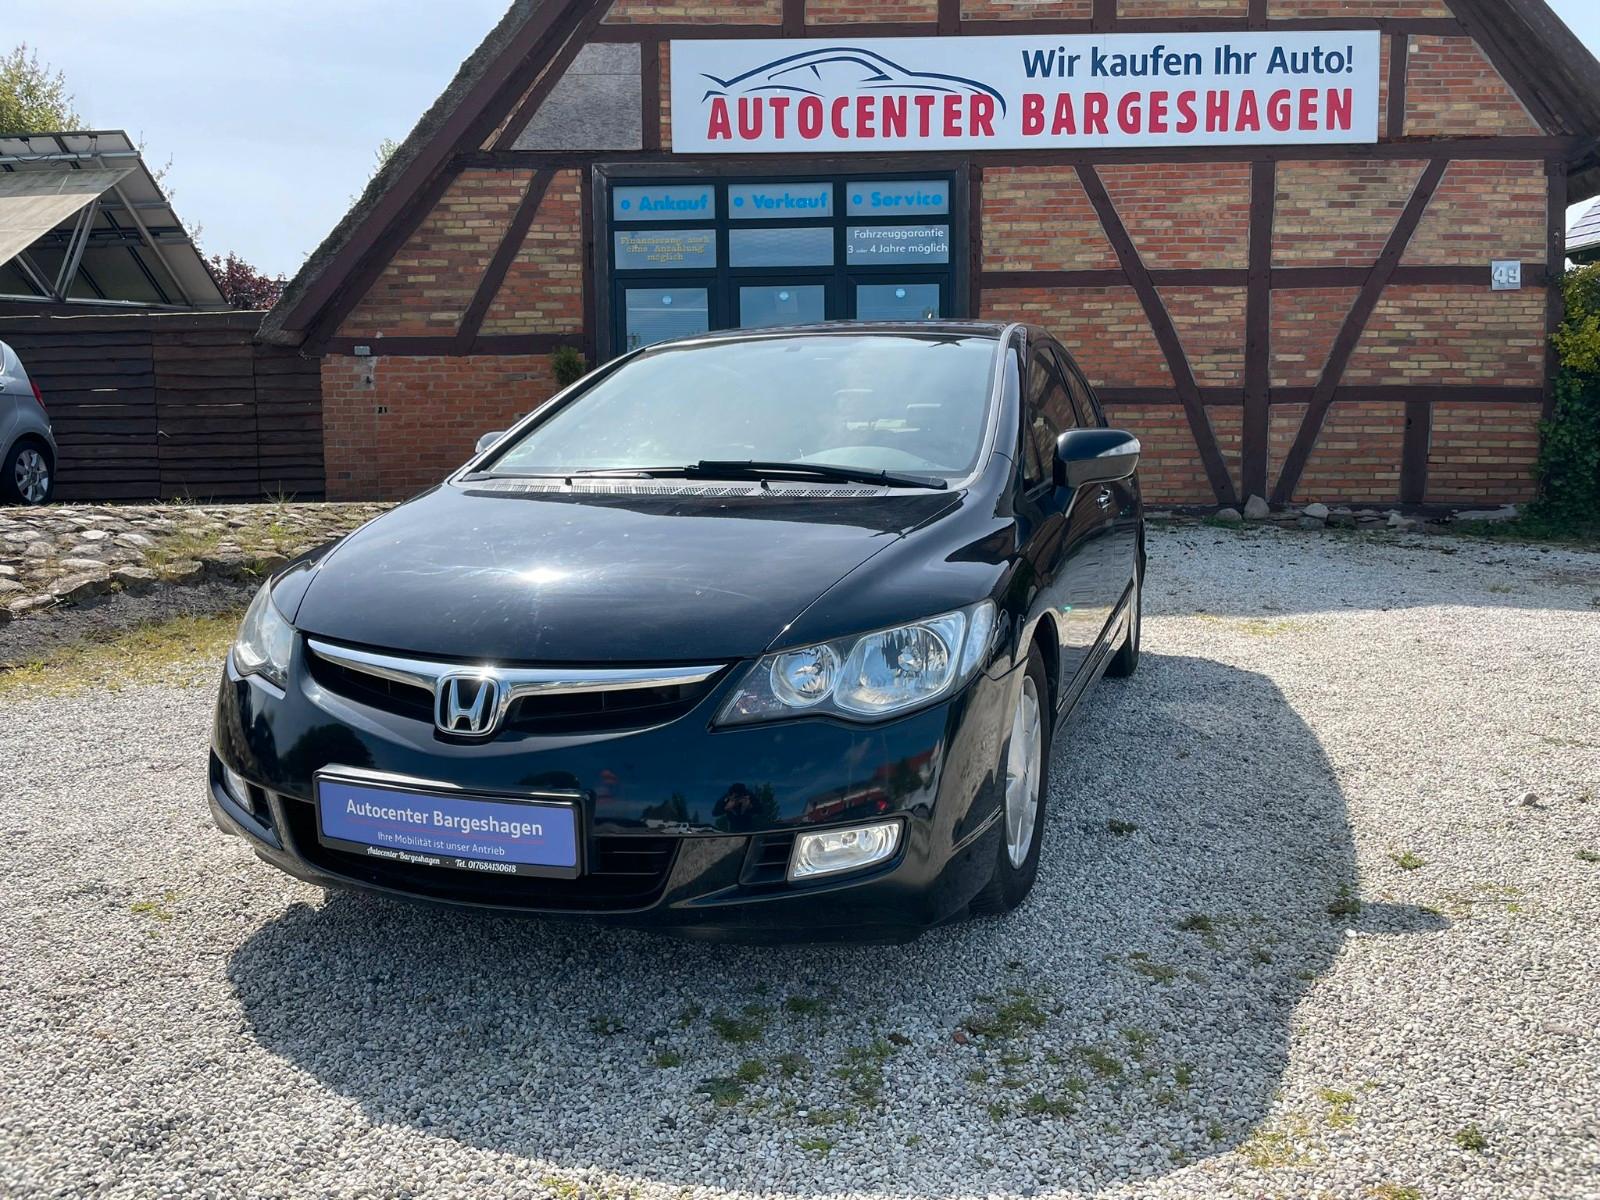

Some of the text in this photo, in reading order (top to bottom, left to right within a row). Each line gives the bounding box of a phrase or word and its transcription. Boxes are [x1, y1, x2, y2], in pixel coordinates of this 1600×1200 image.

[1022, 45, 1353, 78] Wir kaufen Ihr Auto!
[707, 88, 1353, 140] AUTOCENTER BARGESHAGEN
[640, 192, 708, 211] Ankauf
[752, 192, 828, 209] Verkauf
[871, 191, 944, 208] Service
[854, 228, 944, 240] Fahrzeuggarantie
[655, 244, 705, 255] Anzahlung
[847, 245, 854, 254] 3
[870, 245, 876, 253] 4
[879, 244, 906, 253] Jahre
[908, 243, 948, 255] möglich
[1493, 266, 1520, 284] 49
[346, 798, 543, 839] Autocenter Bargeshagen
[377, 831, 505, 856] Ihre Mobilität ist unser Antrieb
[367, 846, 398, 859] Autocenter
[398, 851, 440, 866] Bargeshagen
